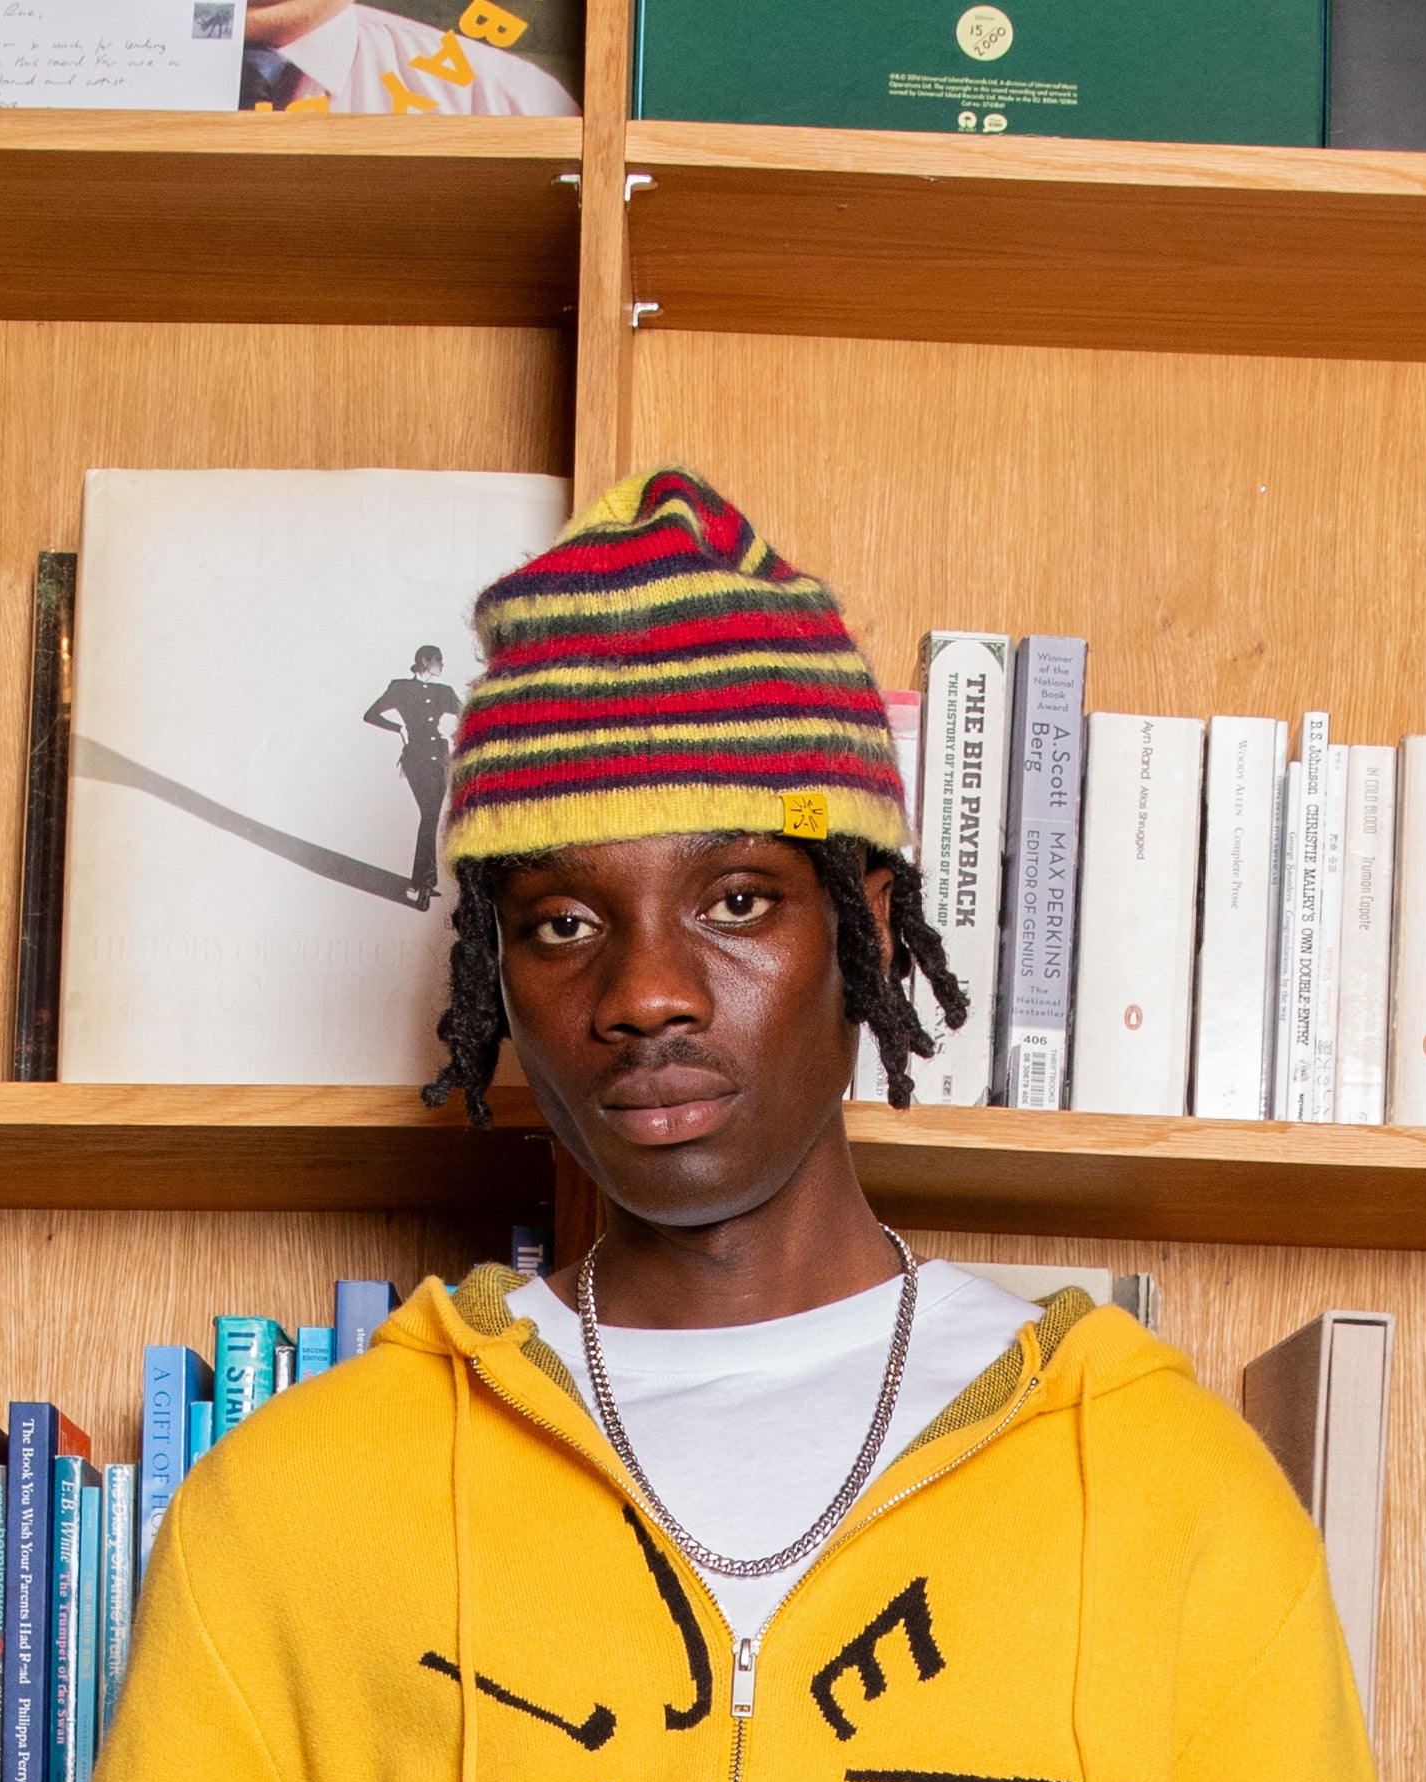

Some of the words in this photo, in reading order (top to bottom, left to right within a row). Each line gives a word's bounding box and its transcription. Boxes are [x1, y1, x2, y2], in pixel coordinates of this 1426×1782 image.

[965, 674, 986, 733] THE
[962, 741, 983, 788] BIG
[1025, 722, 1049, 772] Berg
[956, 796, 979, 927] PAYBACK
[1048, 832, 1066, 880] MAX
[1044, 888, 1064, 979] PERKINS
